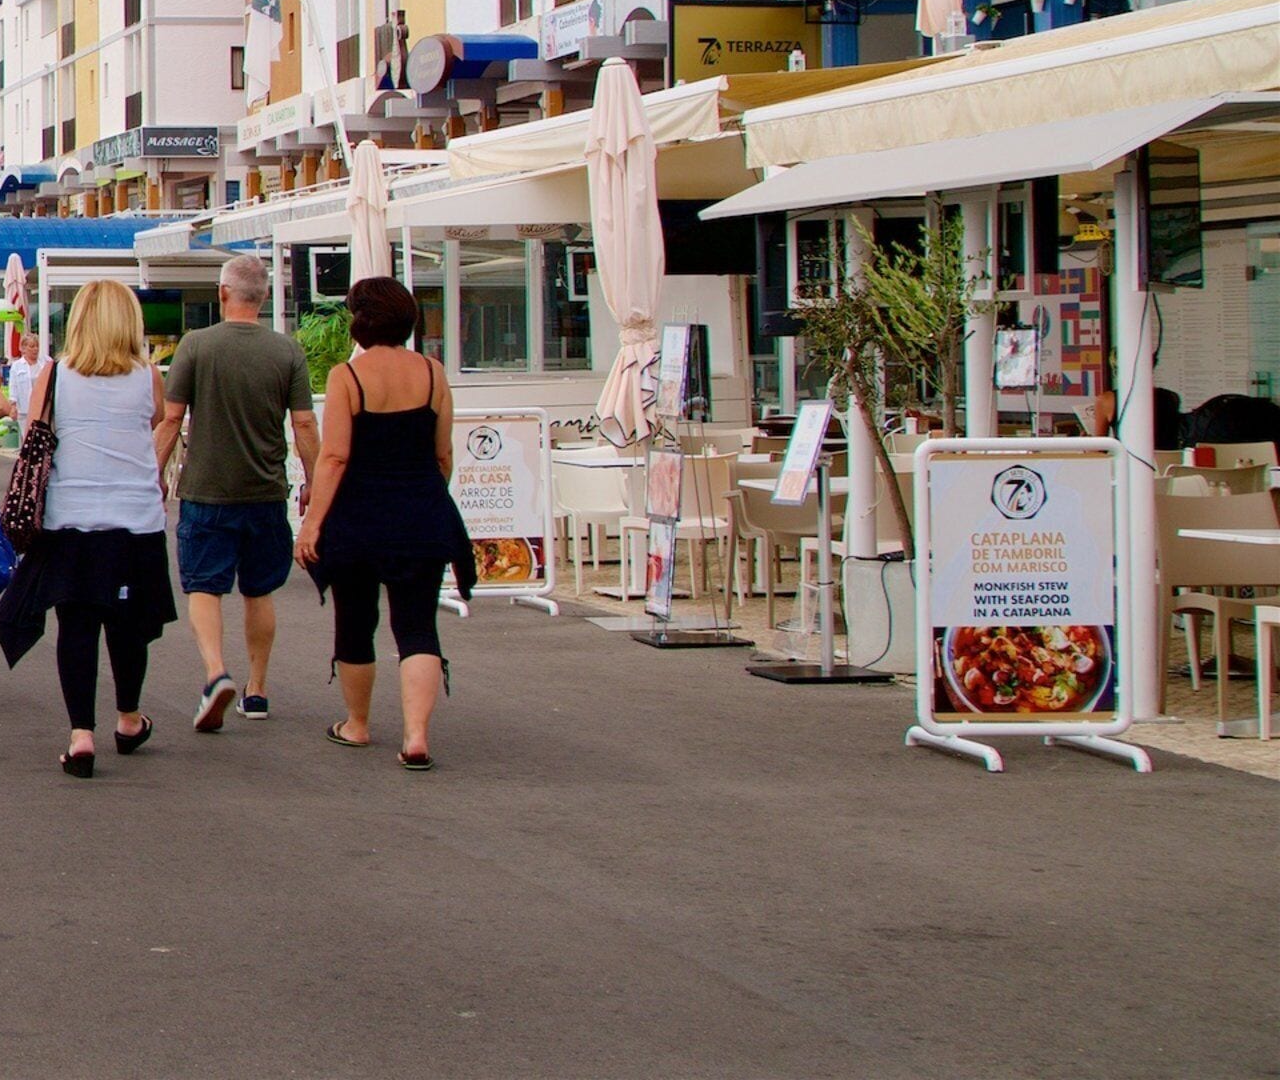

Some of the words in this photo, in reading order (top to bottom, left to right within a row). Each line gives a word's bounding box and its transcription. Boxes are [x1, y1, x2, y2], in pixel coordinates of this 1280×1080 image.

[726, 40, 803, 53] TERRAZZA
[147, 136, 203, 147] MASSAGE
[458, 464, 512, 473] ESPECIALIDADE
[458, 473, 476, 484] DA
[479, 472, 513, 484] CASA
[460, 487, 497, 498] ARROZ
[499, 486, 514, 497] DE
[460, 498, 514, 509] MARISCO
[499, 524, 515, 533] RICE
[970, 532, 1066, 546] CATAPLANA
[972, 548, 989, 560] DE
[994, 548, 1066, 560] TAMBORIL
[972, 562, 1002, 573] COM
[1007, 561, 1068, 573] MARISCO
[973, 582, 1035, 592] MONKFISH
[1038, 581, 1069, 591] STEW
[973, 595, 1007, 605] WITH
[1011, 594, 1070, 605] SEAFOOD
[973, 608, 987, 617] IN
[990, 608, 999, 617] A
[1002, 607, 1072, 617] CATAPLANA
